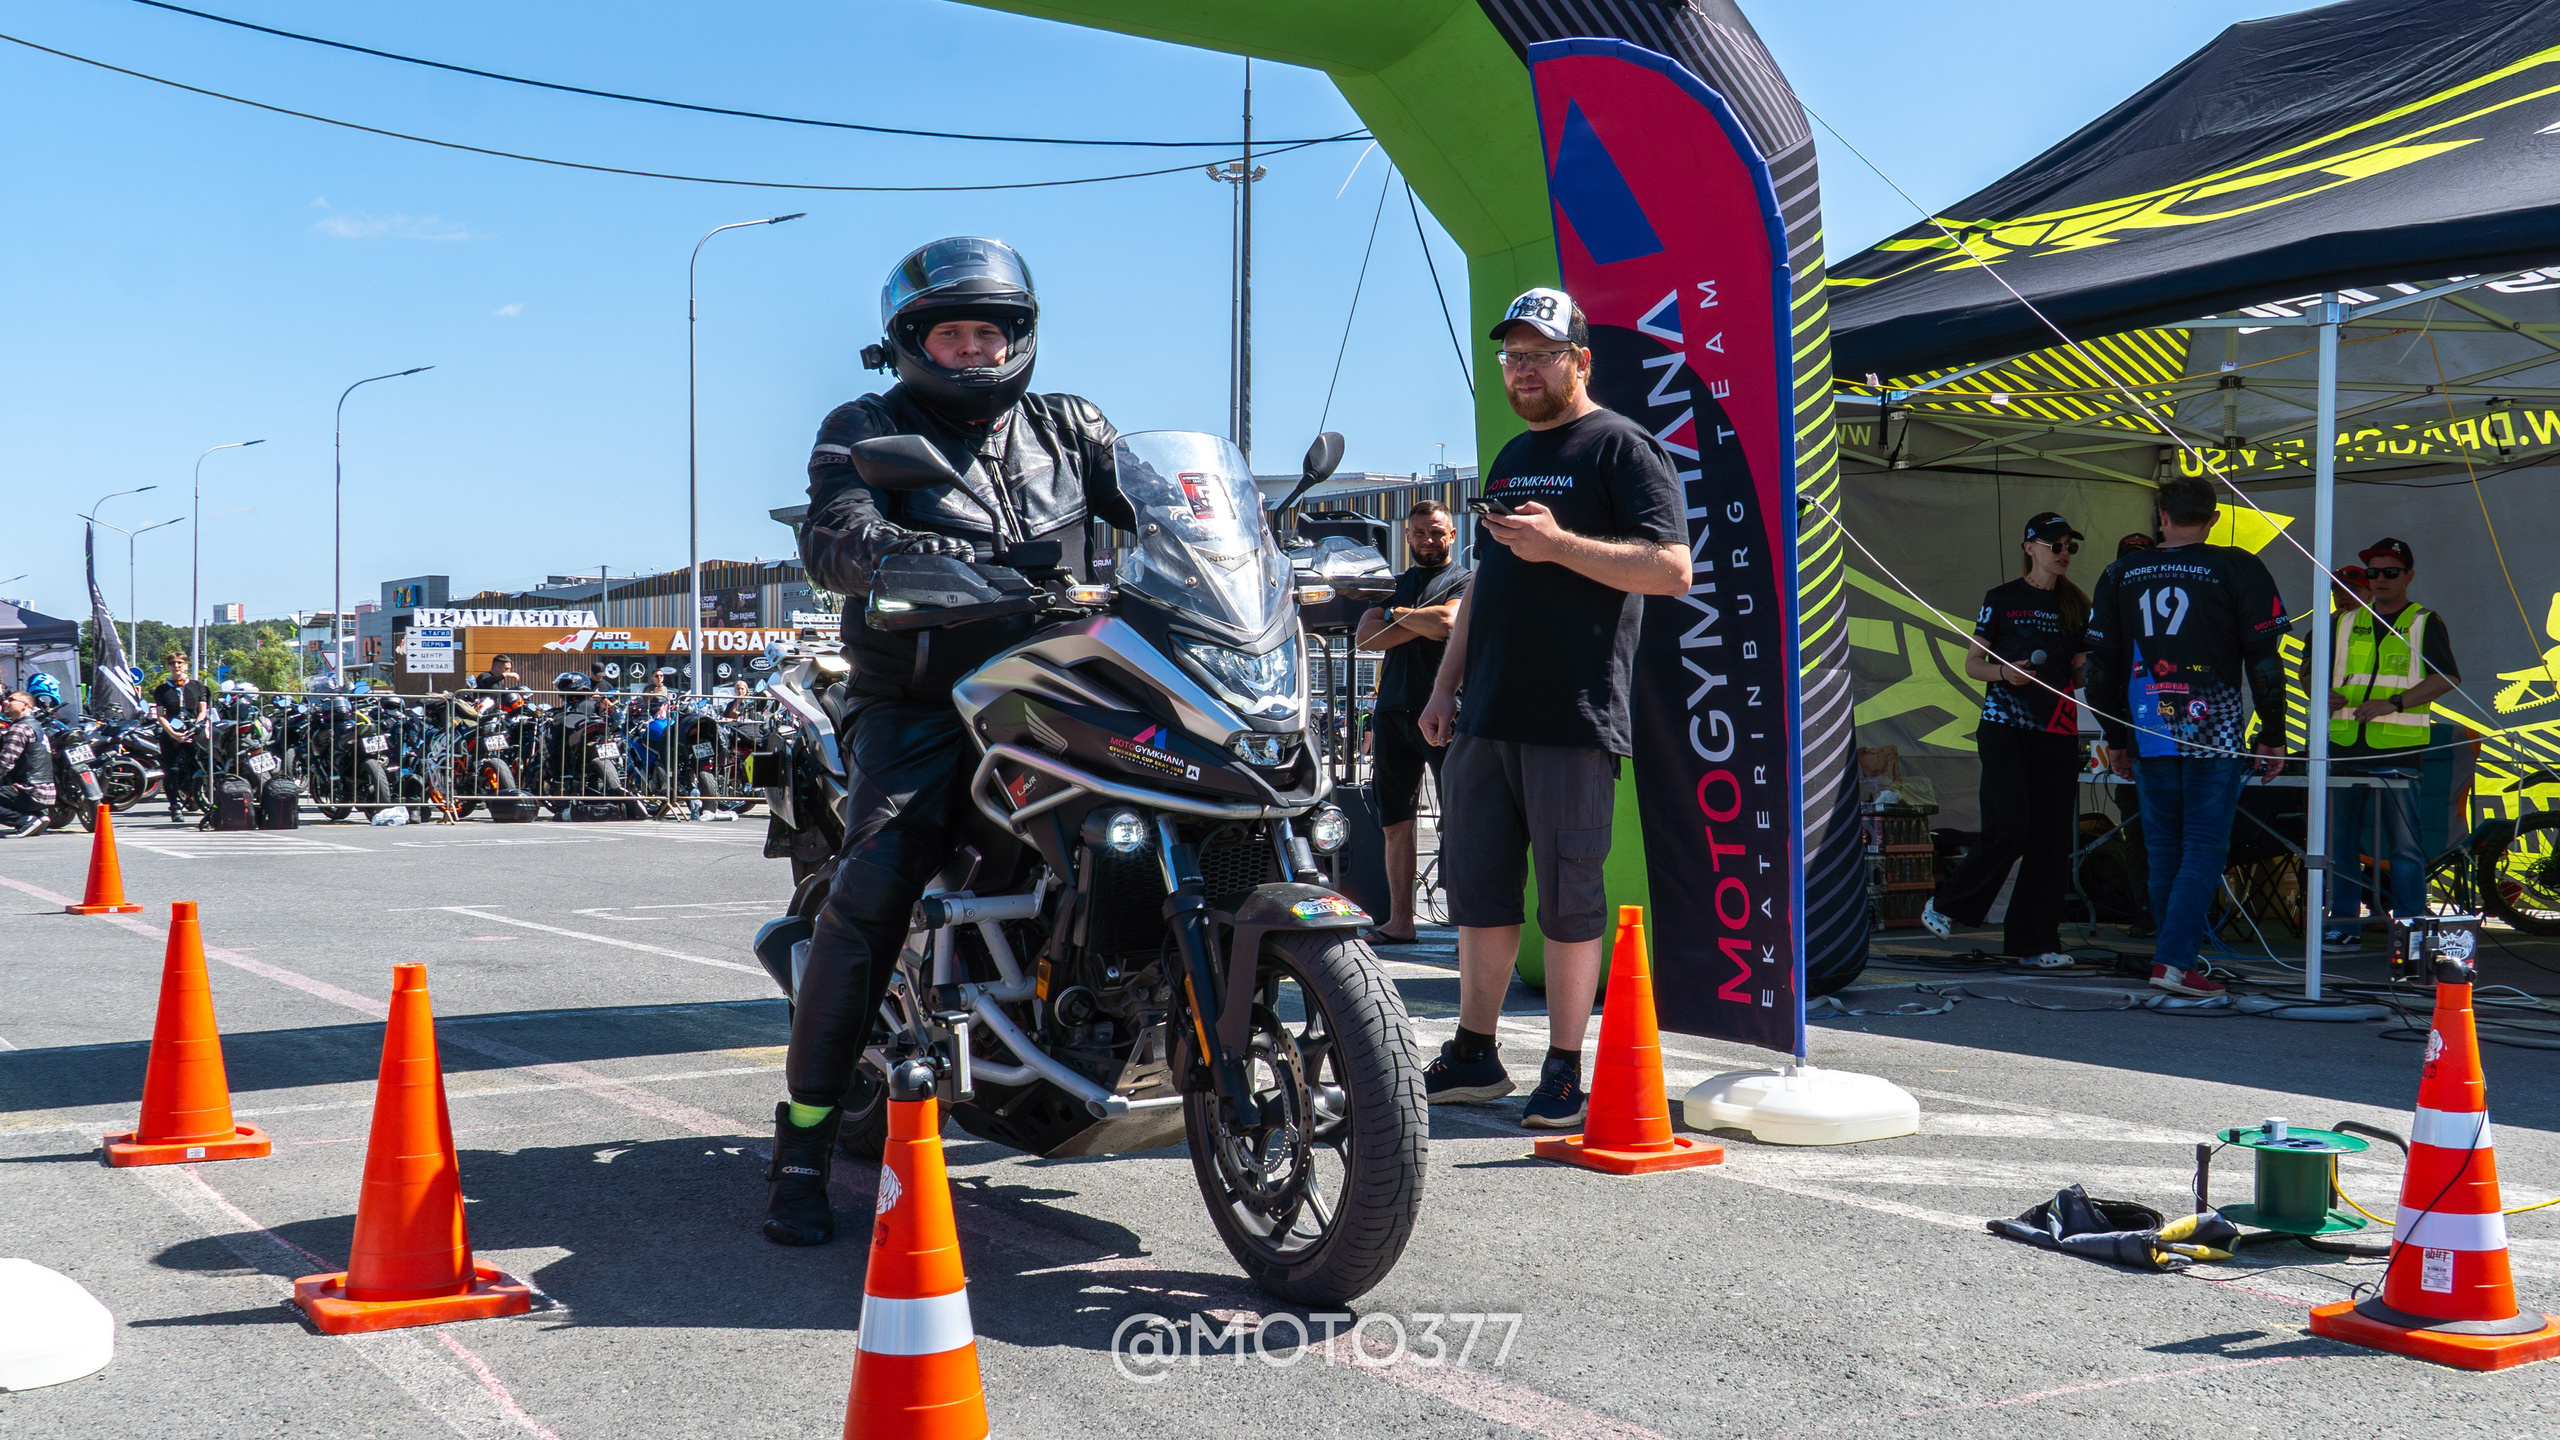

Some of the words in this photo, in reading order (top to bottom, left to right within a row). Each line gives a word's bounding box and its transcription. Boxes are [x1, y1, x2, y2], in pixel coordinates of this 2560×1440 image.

[1697, 279, 1735, 445] TEAM
[1488, 475, 1573, 491] OTOGYMKHANA
[1093, 559, 1111, 568] ORUM
[2124, 565, 2158, 579] ANDREY
[2160, 564, 2212, 575] KHALUEV
[2192, 574, 2218, 584] TEAM
[2138, 586, 2189, 637] 19
[593, 631, 631, 640] АВТО
[592, 640, 650, 650] ЯПОНЕЦ
[1109, 745, 1141, 760] GYMKHANA
[1141, 755, 1154, 764] CUP
[1154, 760, 1170, 769] EKAT
[1110, 736, 1185, 767] MOTOGYMKHANA
[1726, 501, 1775, 1008] EKATERINBURG
[1162, 768, 1178, 777] TEAM
[1016, 774, 1037, 797] LAVR
